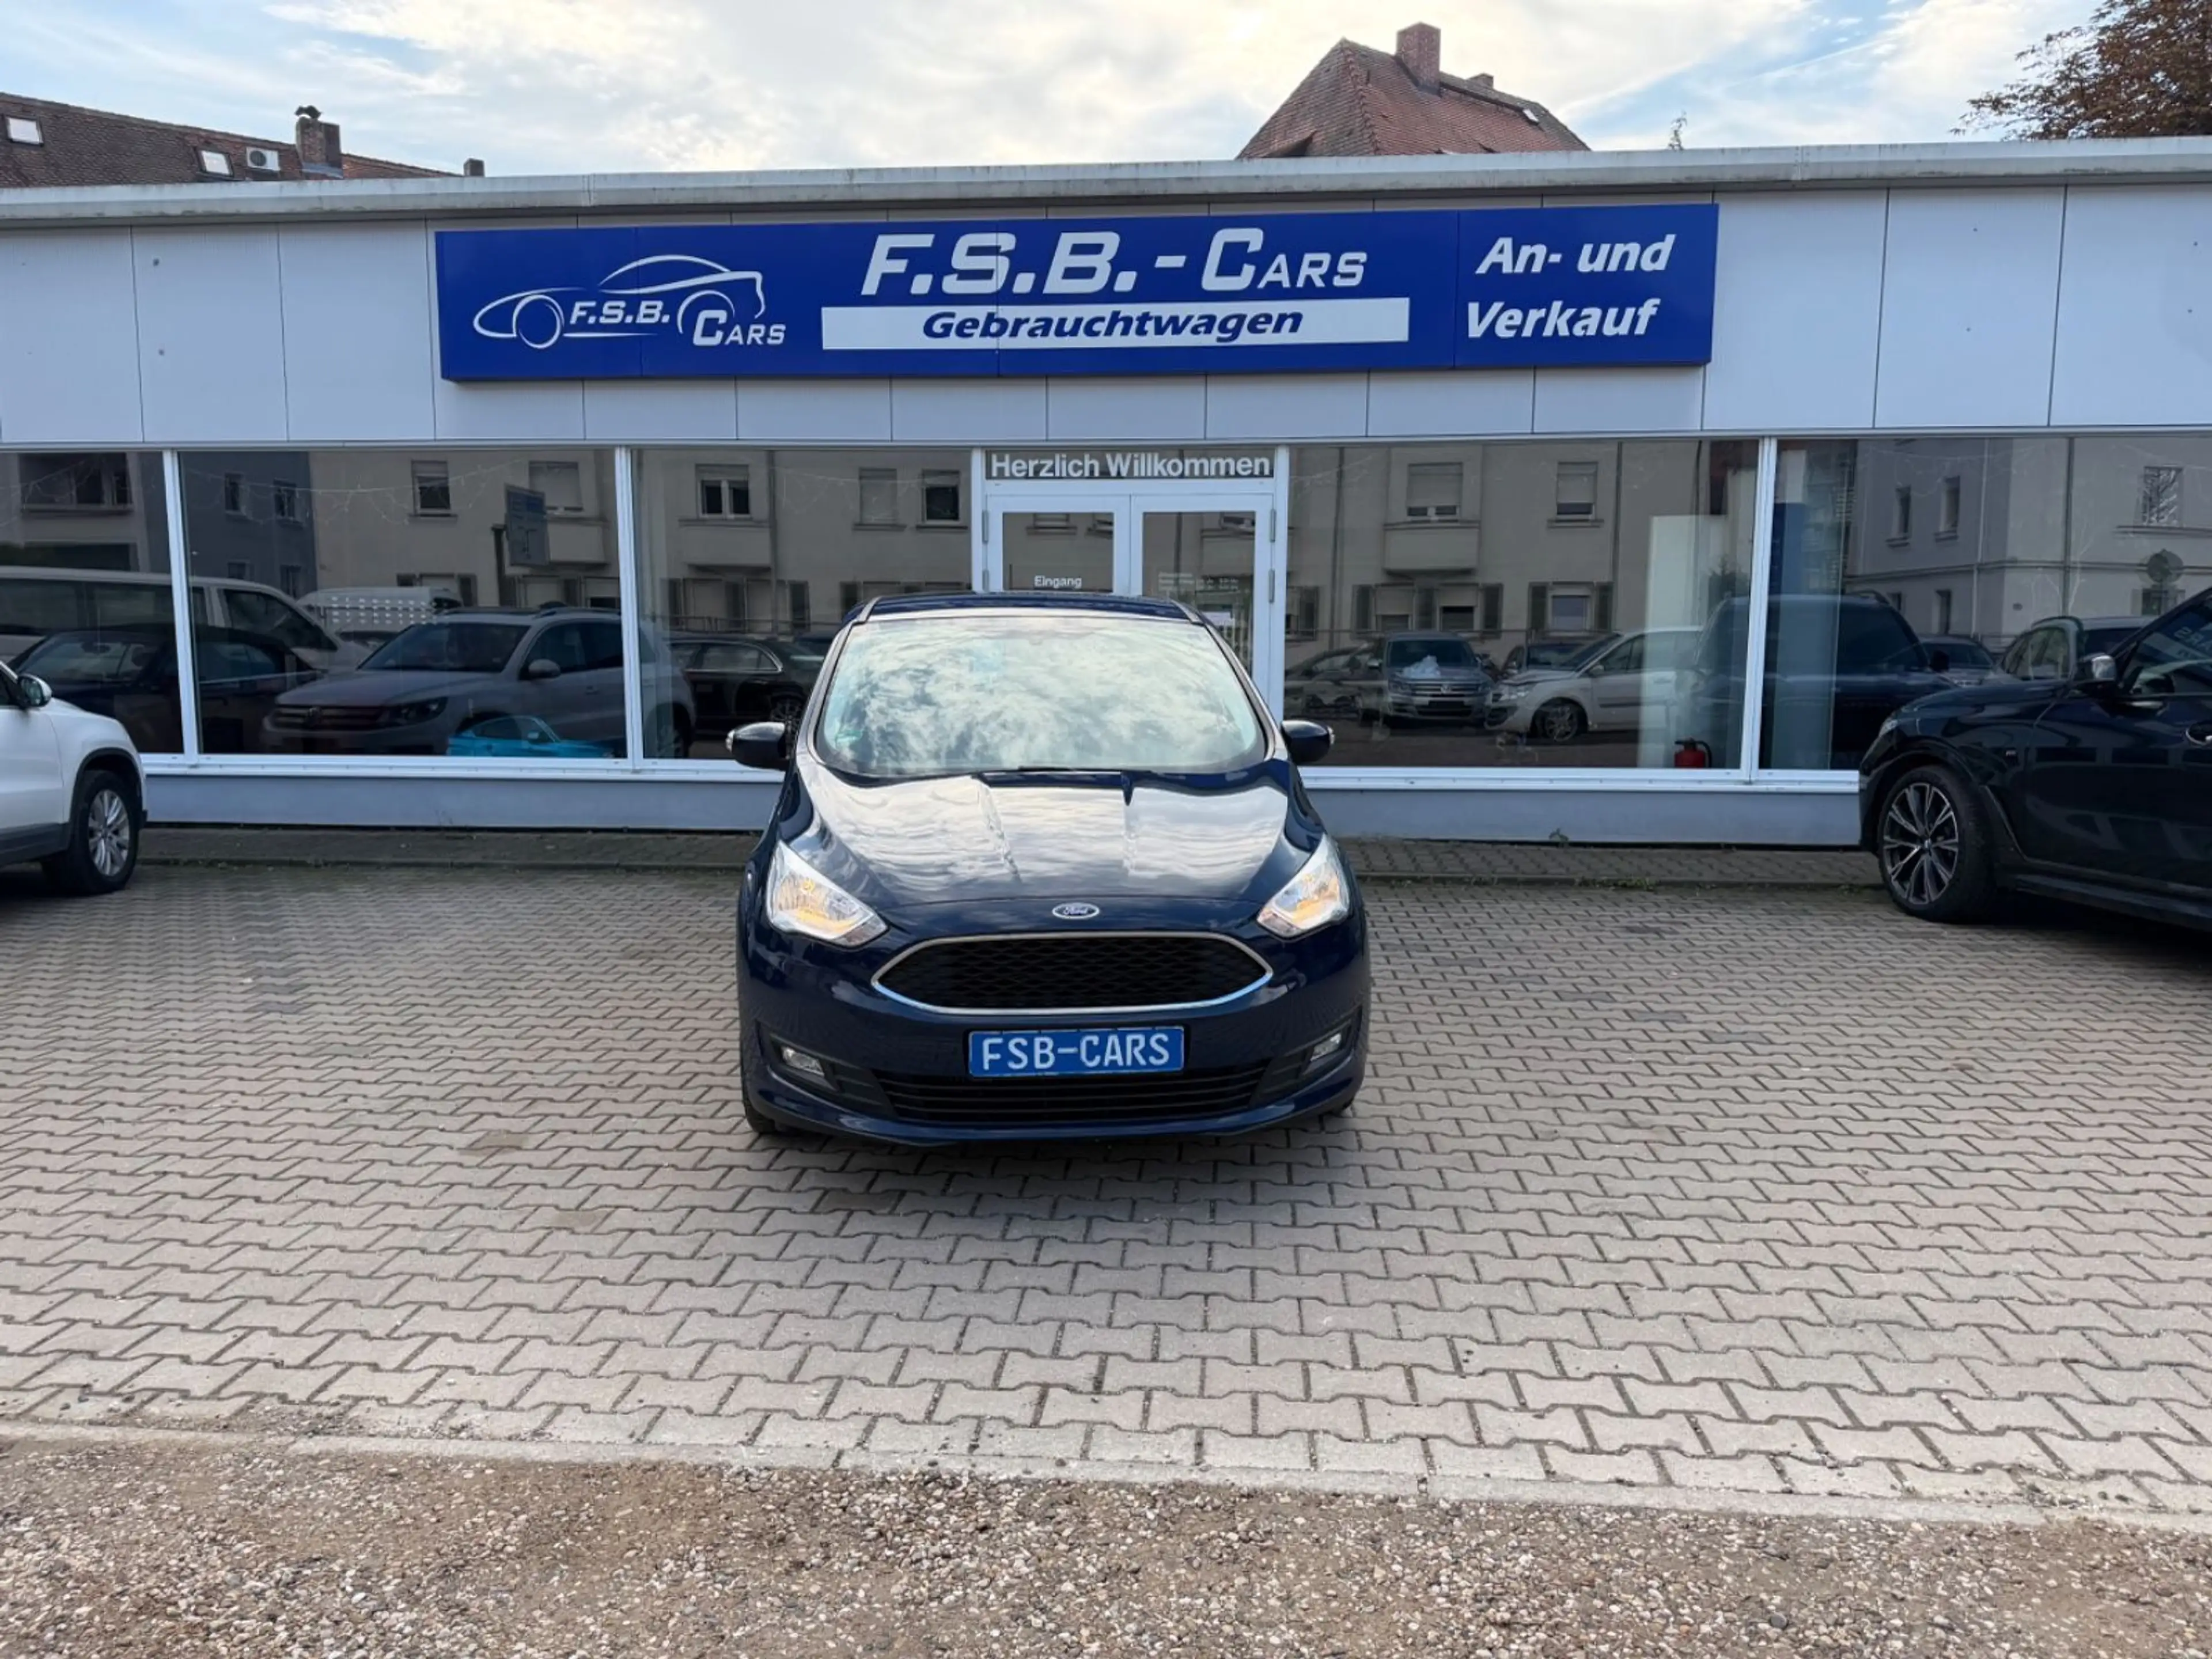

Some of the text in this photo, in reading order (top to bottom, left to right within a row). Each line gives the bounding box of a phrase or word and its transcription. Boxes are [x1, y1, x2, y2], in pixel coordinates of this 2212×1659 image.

[1474, 233, 1676, 275] An- und
[569, 300, 671, 324] F.S.B.
[923, 309, 1304, 344] Gebrauchtwagen
[1467, 297, 1661, 339] Verkauf
[990, 451, 1271, 478] Herzlich Willkommen
[1033, 575, 1082, 589] Eingang
[982, 1033, 1170, 1071] FSB-CARS
